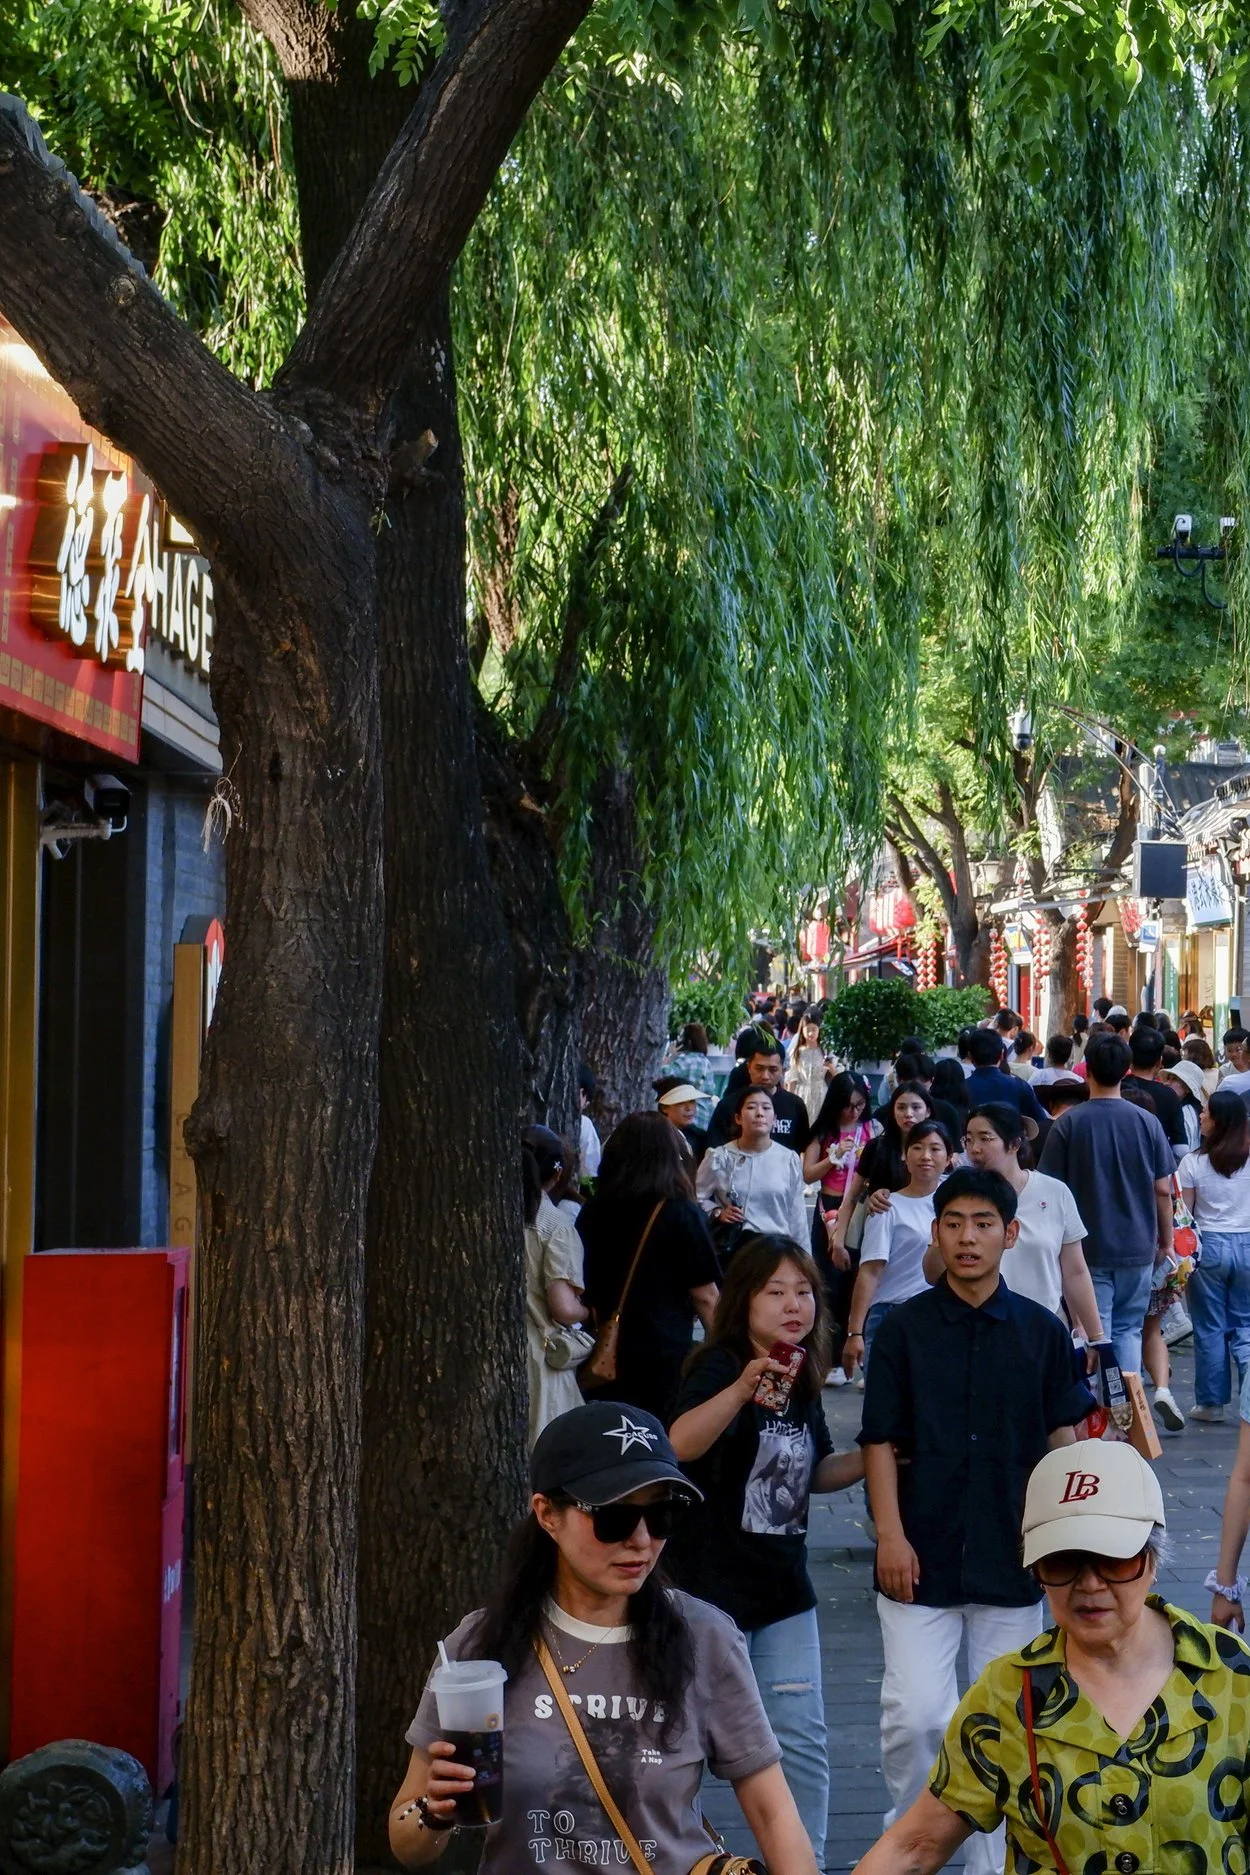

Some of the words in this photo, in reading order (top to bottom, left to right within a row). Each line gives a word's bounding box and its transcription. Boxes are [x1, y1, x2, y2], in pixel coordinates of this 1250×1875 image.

[1058, 1470, 1101, 1504] LB
[534, 1694, 666, 1723] SRIVE
[648, 1757, 663, 1765] Nap
[527, 1809, 575, 1834] TO
[528, 1838, 658, 1865] THRIVE
